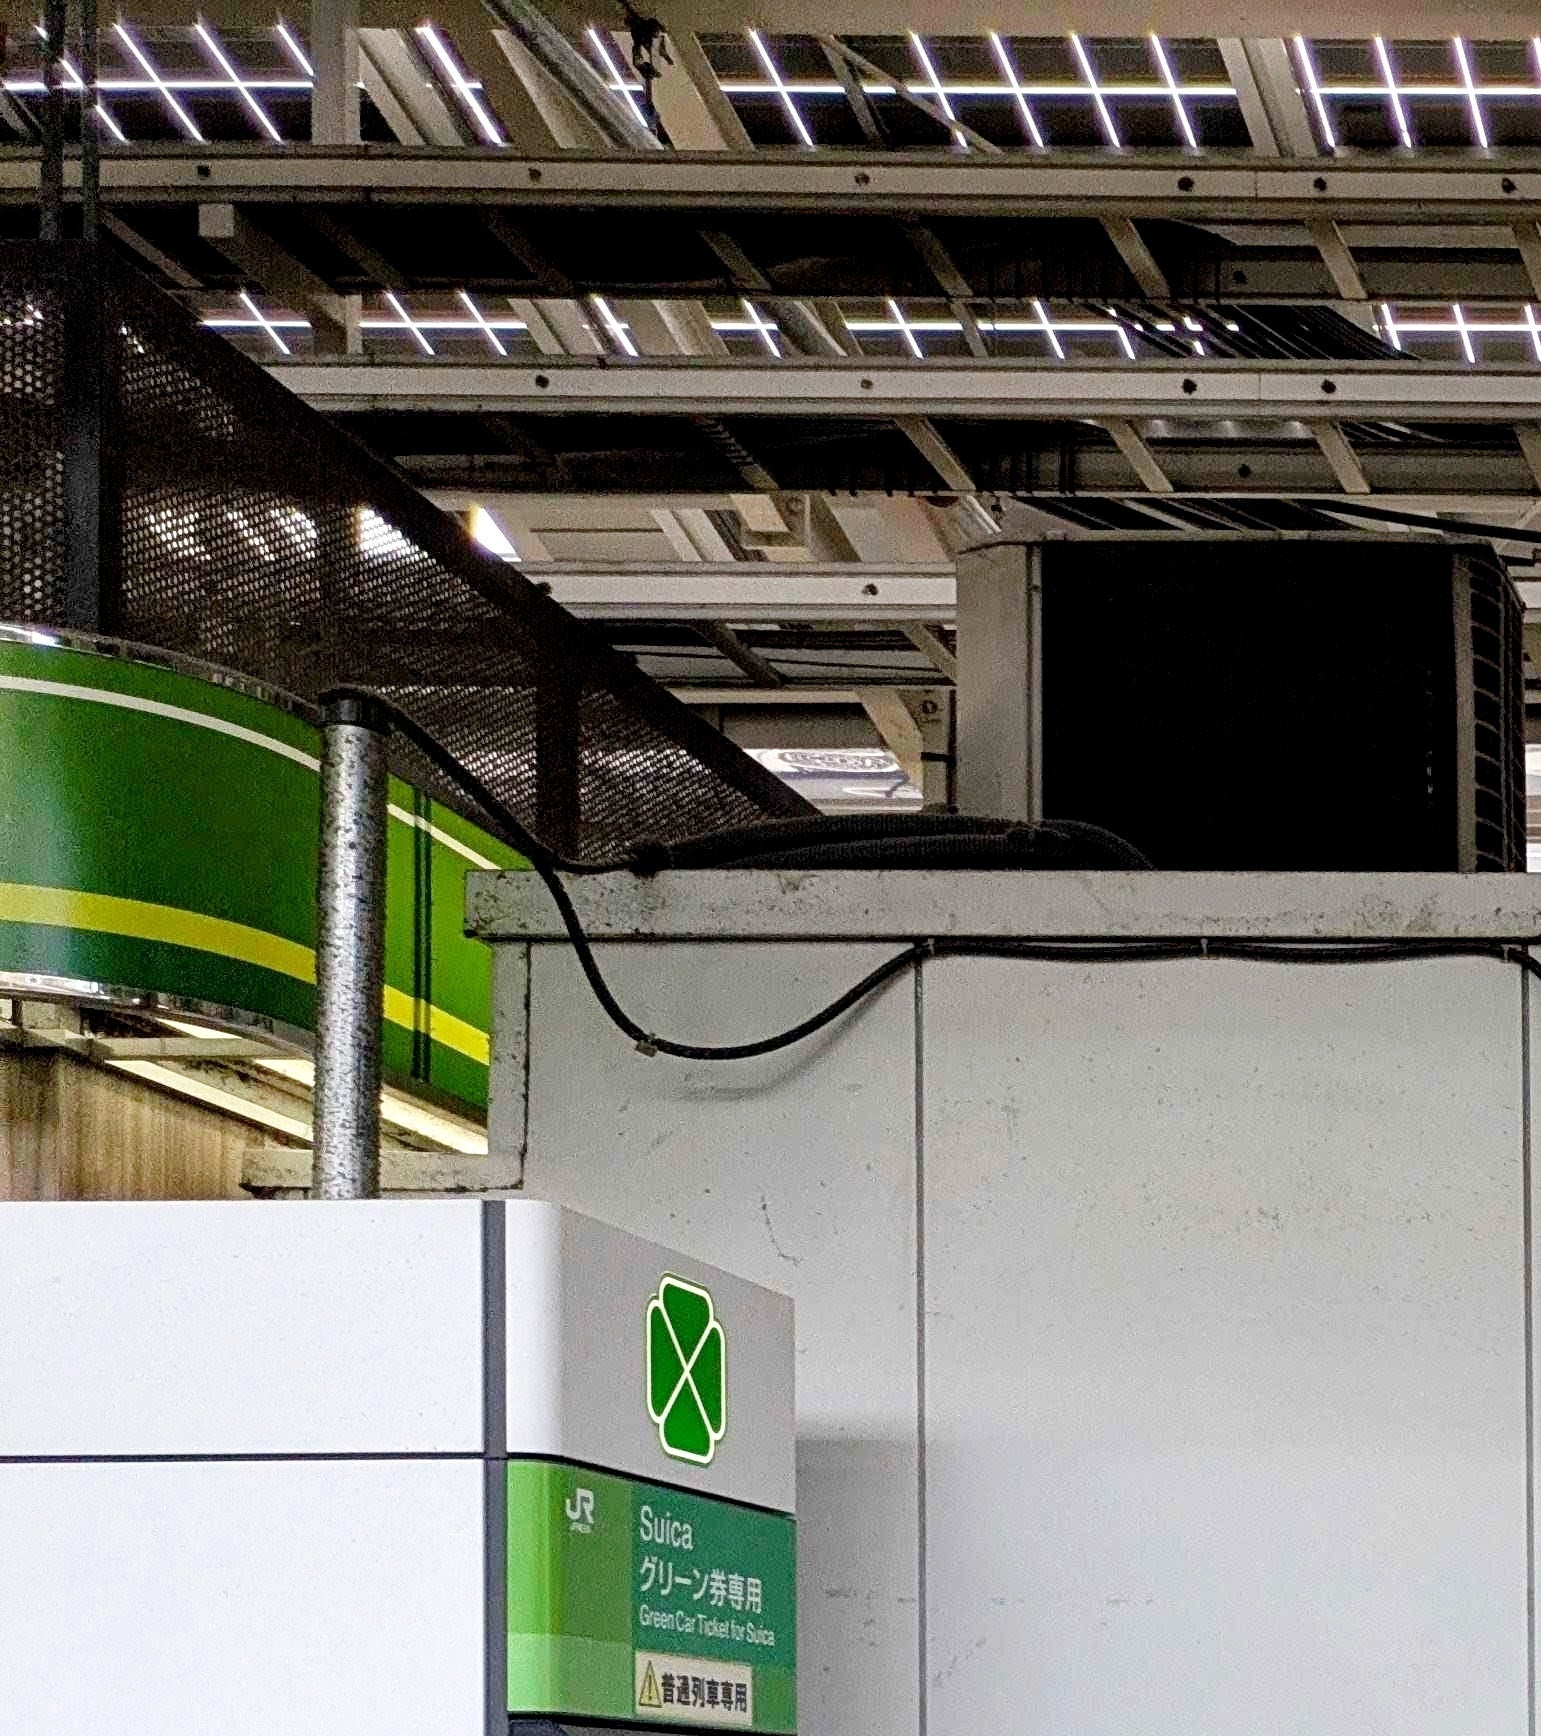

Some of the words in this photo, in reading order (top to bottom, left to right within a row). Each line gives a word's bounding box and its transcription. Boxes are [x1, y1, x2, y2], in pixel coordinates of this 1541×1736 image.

[565, 1488, 595, 1524] JR
[640, 1505, 693, 1550] Suica
[640, 1555, 762, 1613] グリーン券専用
[640, 1605, 674, 1630] Green
[675, 1611, 696, 1633] Car
[698, 1614, 729, 1640] Ticket
[730, 1622, 745, 1641] for
[746, 1623, 775, 1646] Suica
[661, 1672, 748, 1712] 普通列車専用
